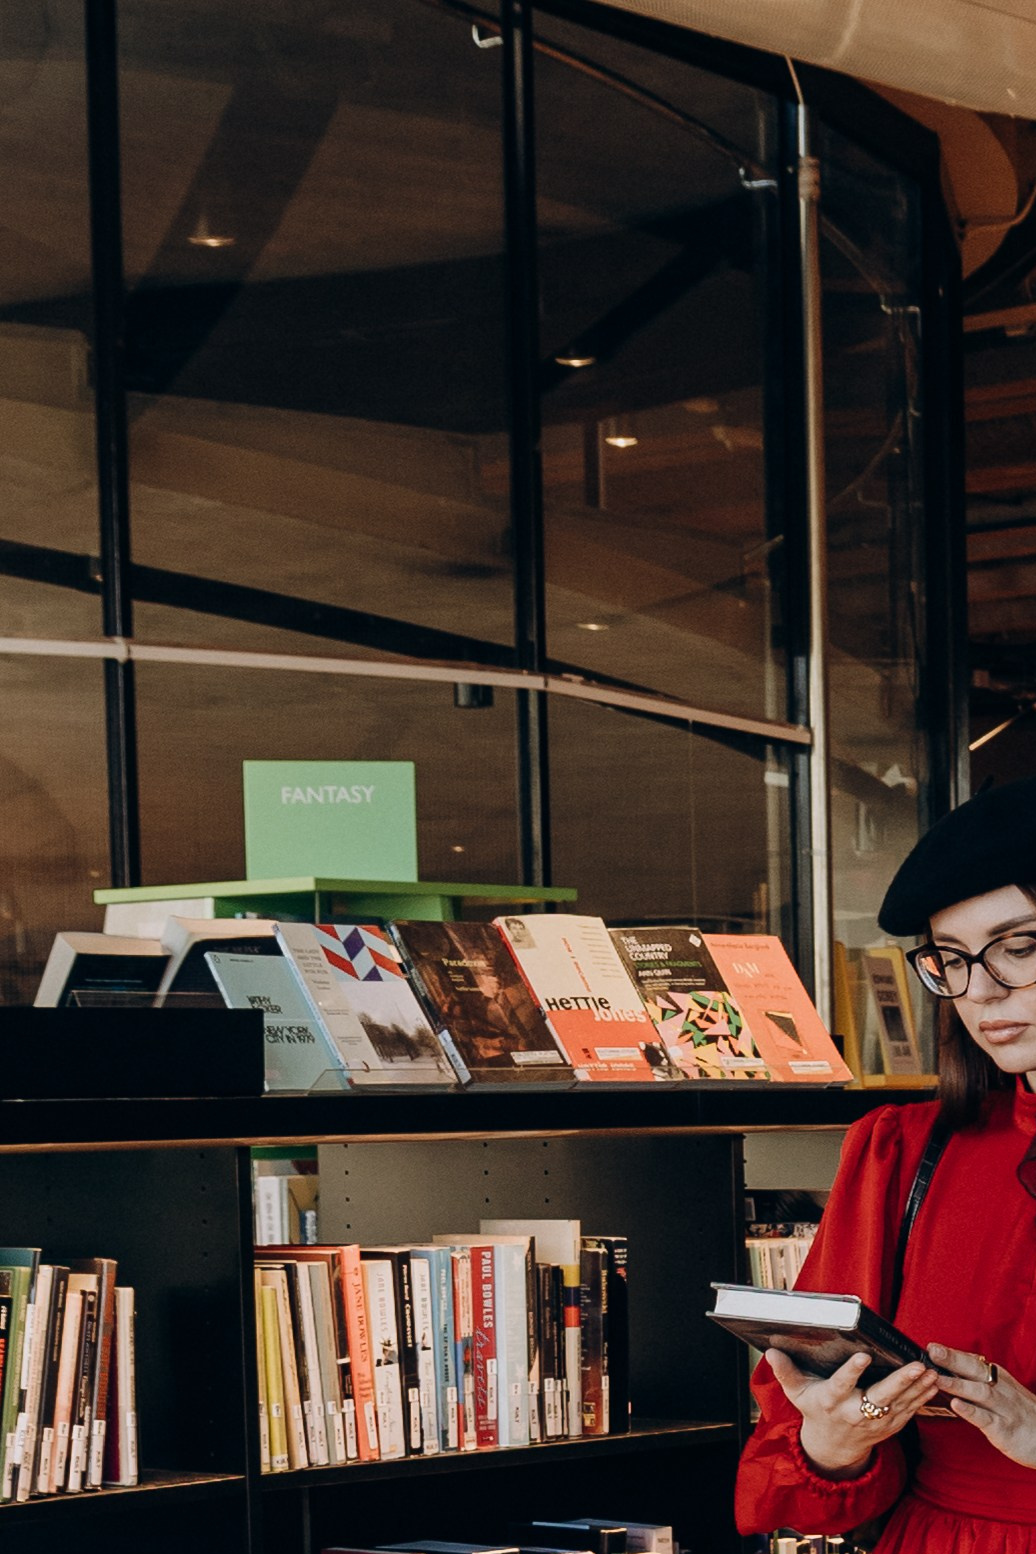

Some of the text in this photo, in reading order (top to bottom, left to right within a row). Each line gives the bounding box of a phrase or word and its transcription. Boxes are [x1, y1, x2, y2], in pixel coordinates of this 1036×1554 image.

[281, 784, 375, 804] FANTASY
[620, 936, 637, 945] THE
[624, 944, 673, 953] UNMAPPED
[629, 951, 669, 962] COUNTRY
[594, 1009, 646, 1023] Jones
[480, 1251, 493, 1329] PAUL BOWLES
[352, 1282, 368, 1363] JANE BOWLES
